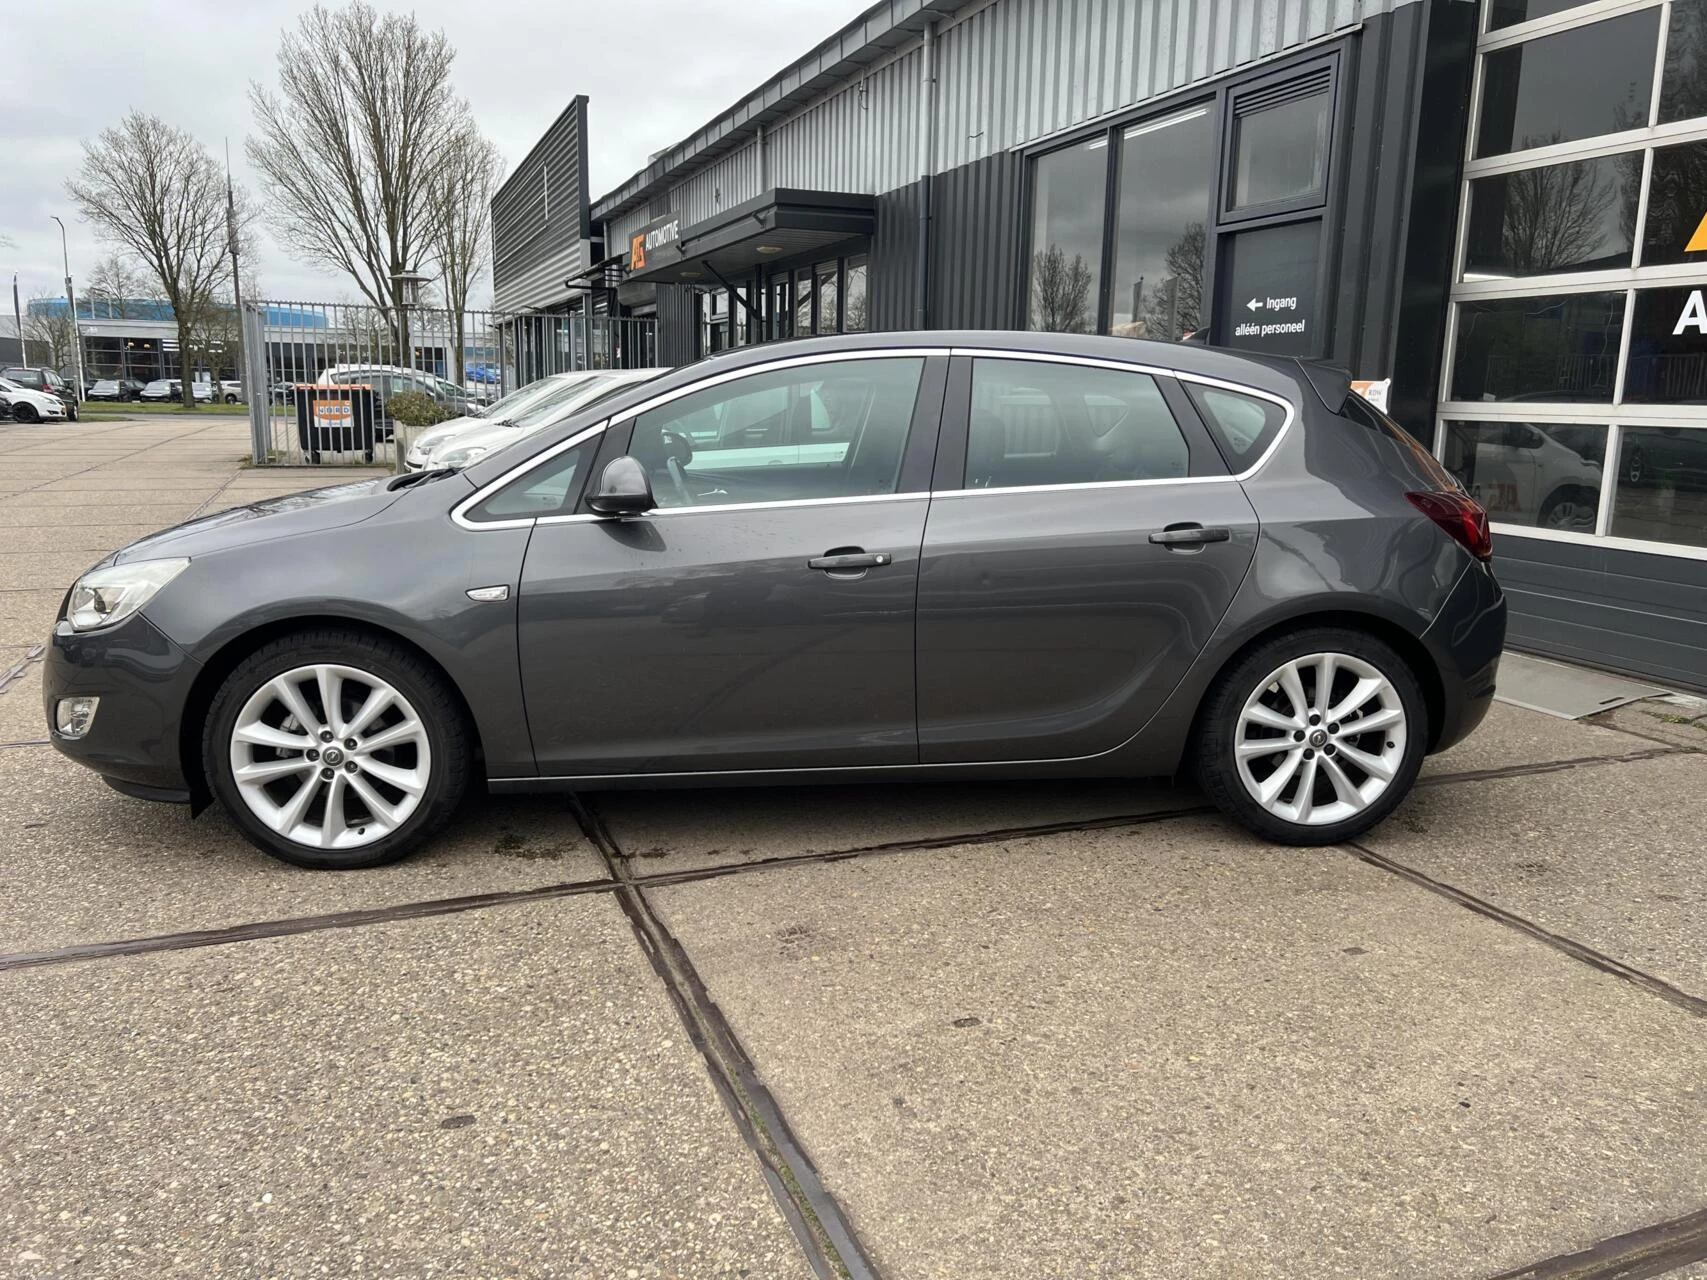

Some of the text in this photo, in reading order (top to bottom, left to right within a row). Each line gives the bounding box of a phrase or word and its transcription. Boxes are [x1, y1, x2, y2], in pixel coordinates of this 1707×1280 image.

[645, 220, 679, 251] AUTOMOTIVE
[1266, 296, 1297, 312] Ingang
[1235, 319, 1306, 338] alléén personeel
